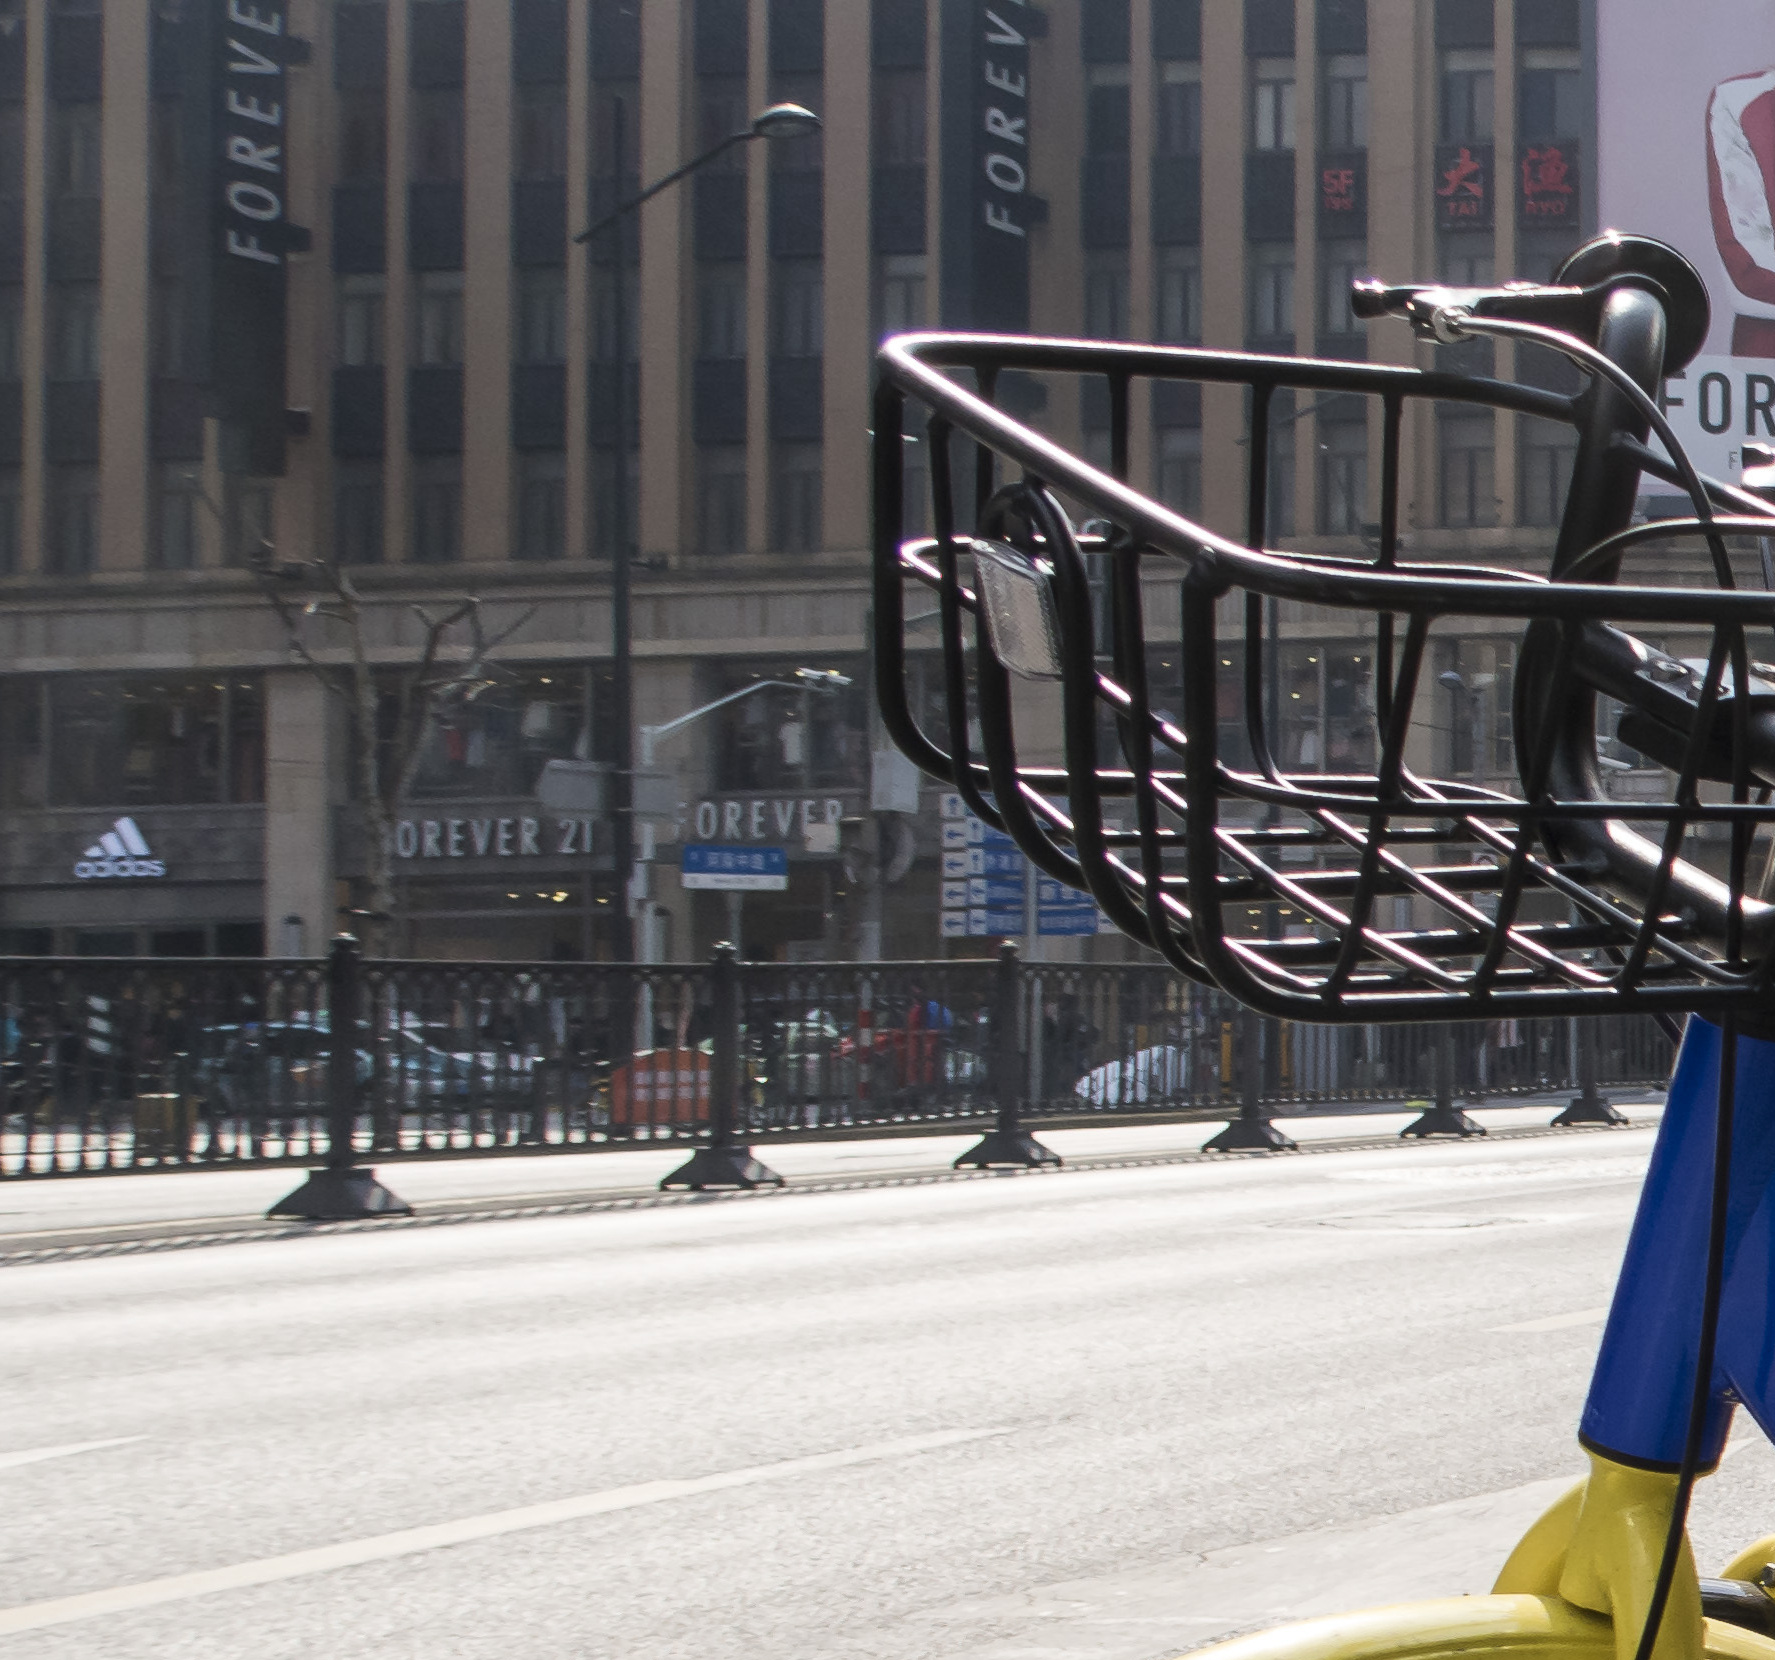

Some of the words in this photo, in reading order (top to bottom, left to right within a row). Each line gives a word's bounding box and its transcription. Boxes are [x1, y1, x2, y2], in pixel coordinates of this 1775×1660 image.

[984, 0, 1032, 237] FOREV
[395, 816, 541, 858] OREVER
[556, 817, 594, 854] 21
[74, 857, 167, 879] adidas
